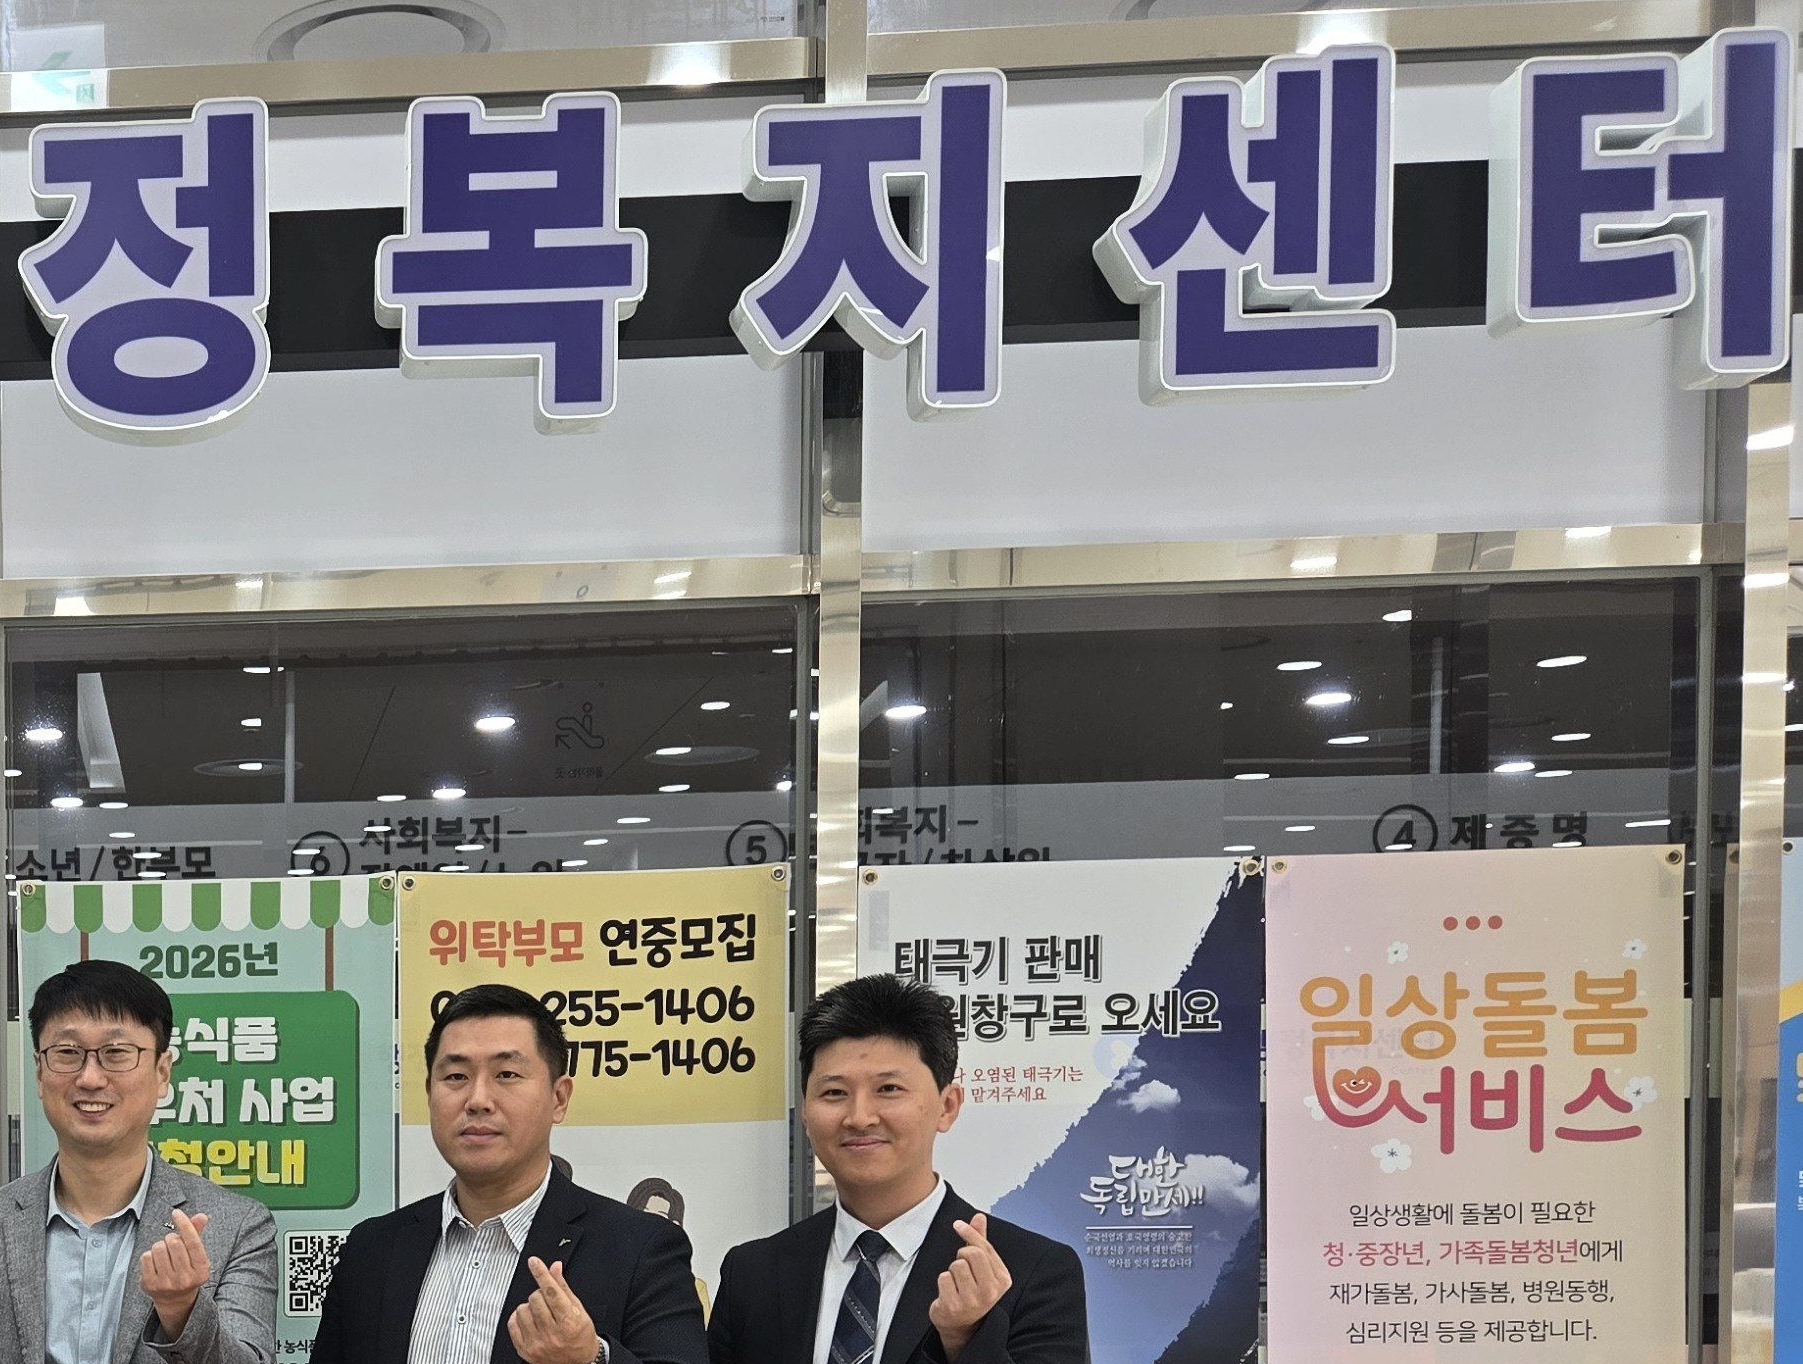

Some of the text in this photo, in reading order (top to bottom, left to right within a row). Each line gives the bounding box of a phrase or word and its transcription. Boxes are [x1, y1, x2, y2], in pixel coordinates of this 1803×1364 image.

[428, 912, 756, 967] 위탁부모 연중모집
[895, 935, 1102, 985] 태극기 판매
[139, 942, 279, 979] 2026년
[1101, 989, 1221, 1037] 오세요
[1299, 969, 1649, 1059] 일상돌봄
[971, 1066, 1083, 1083] 오염된 태극기는
[239, 1076, 334, 1123] 사업
[1377, 1064, 1643, 1155] 서비스
[1108, 1146, 1187, 1187] 대한
[1349, 1201, 1595, 1227] 일상생활에 돌봄이 필요한
[1439, 1239, 1623, 1266] 가족돌봄청년에게
[1329, 1279, 1615, 1306] 재가돌봄, 가사돌봄, 병원동행,
[1346, 1319, 1598, 1344] 심리지원 등을 제공합니다.
